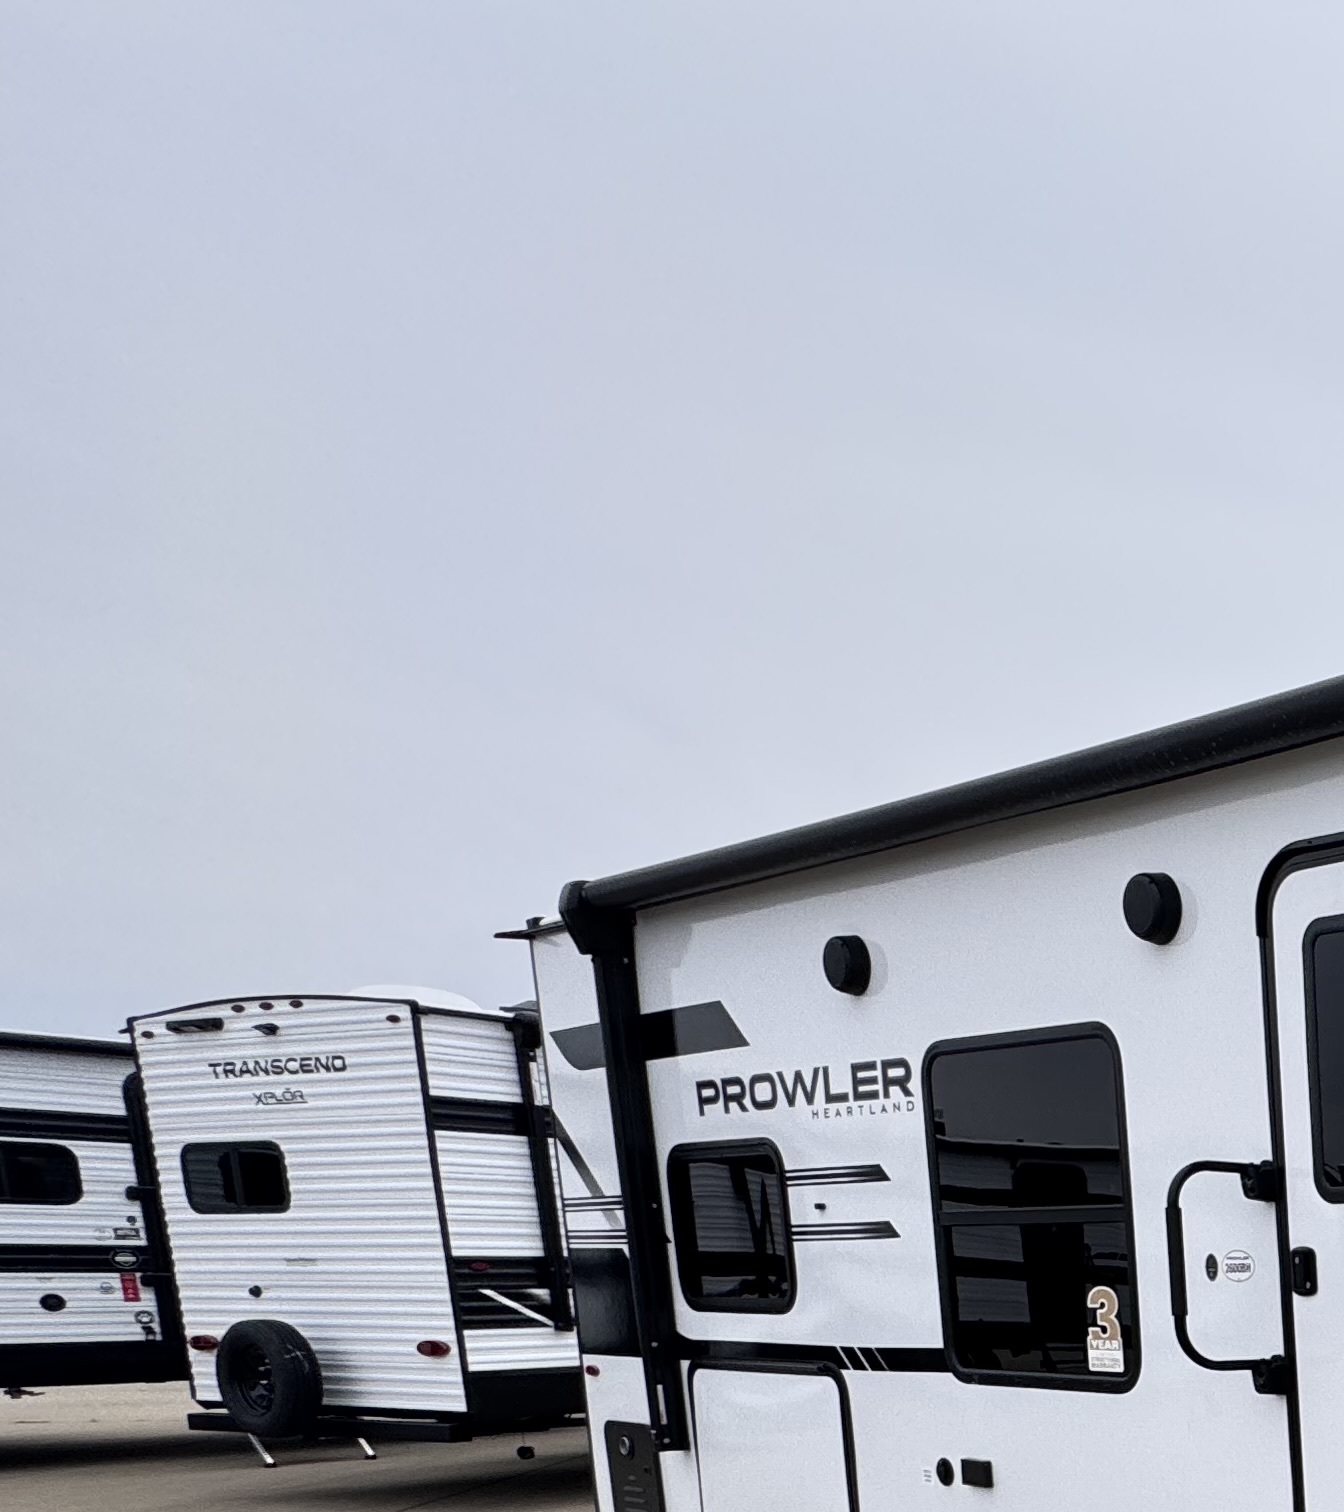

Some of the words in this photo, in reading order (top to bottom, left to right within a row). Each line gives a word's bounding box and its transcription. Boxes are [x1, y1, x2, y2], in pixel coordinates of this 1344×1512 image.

[208, 1055, 347, 1079] TRANSCEND
[695, 1057, 914, 1117] PROWLER
[812, 1100, 915, 1119] HEARTLAND
[1087, 1285, 1120, 1340] 3
[1091, 1340, 1119, 1350] YEAR
